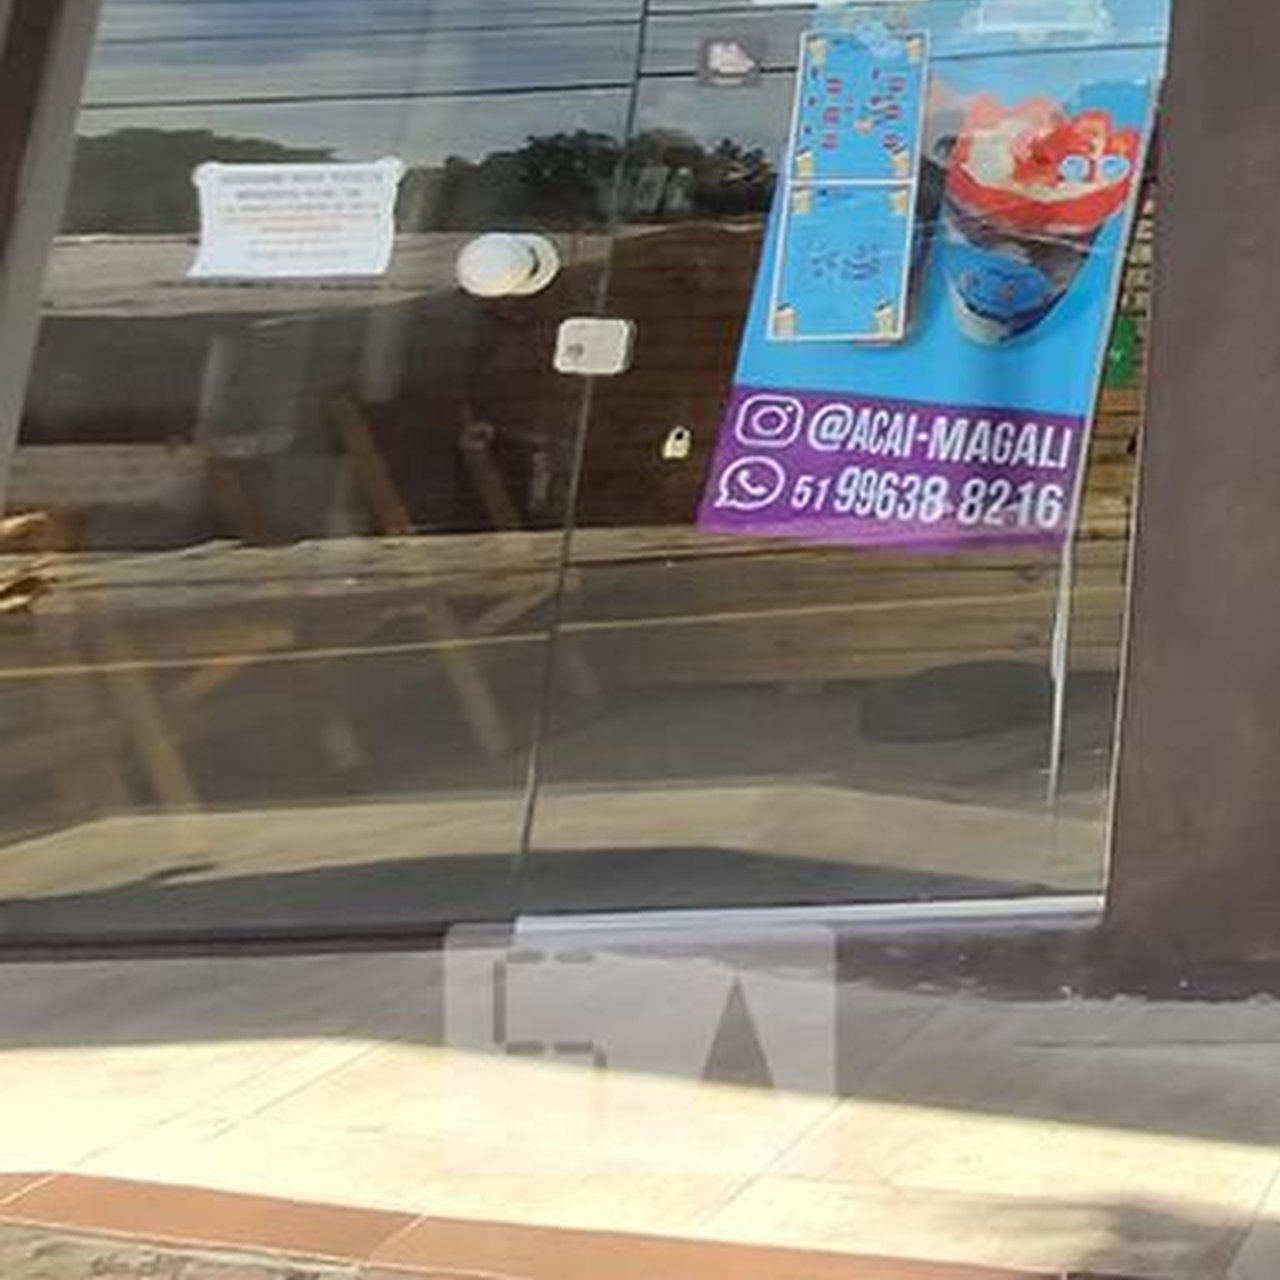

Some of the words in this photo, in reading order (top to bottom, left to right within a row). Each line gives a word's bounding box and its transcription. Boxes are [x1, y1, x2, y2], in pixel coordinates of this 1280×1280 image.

[807, 403, 1072, 470] @ACAI-MAGALI
[790, 474, 832, 512] 51
[832, 466, 949, 524] 99638
[957, 477, 1064, 529] 8216
